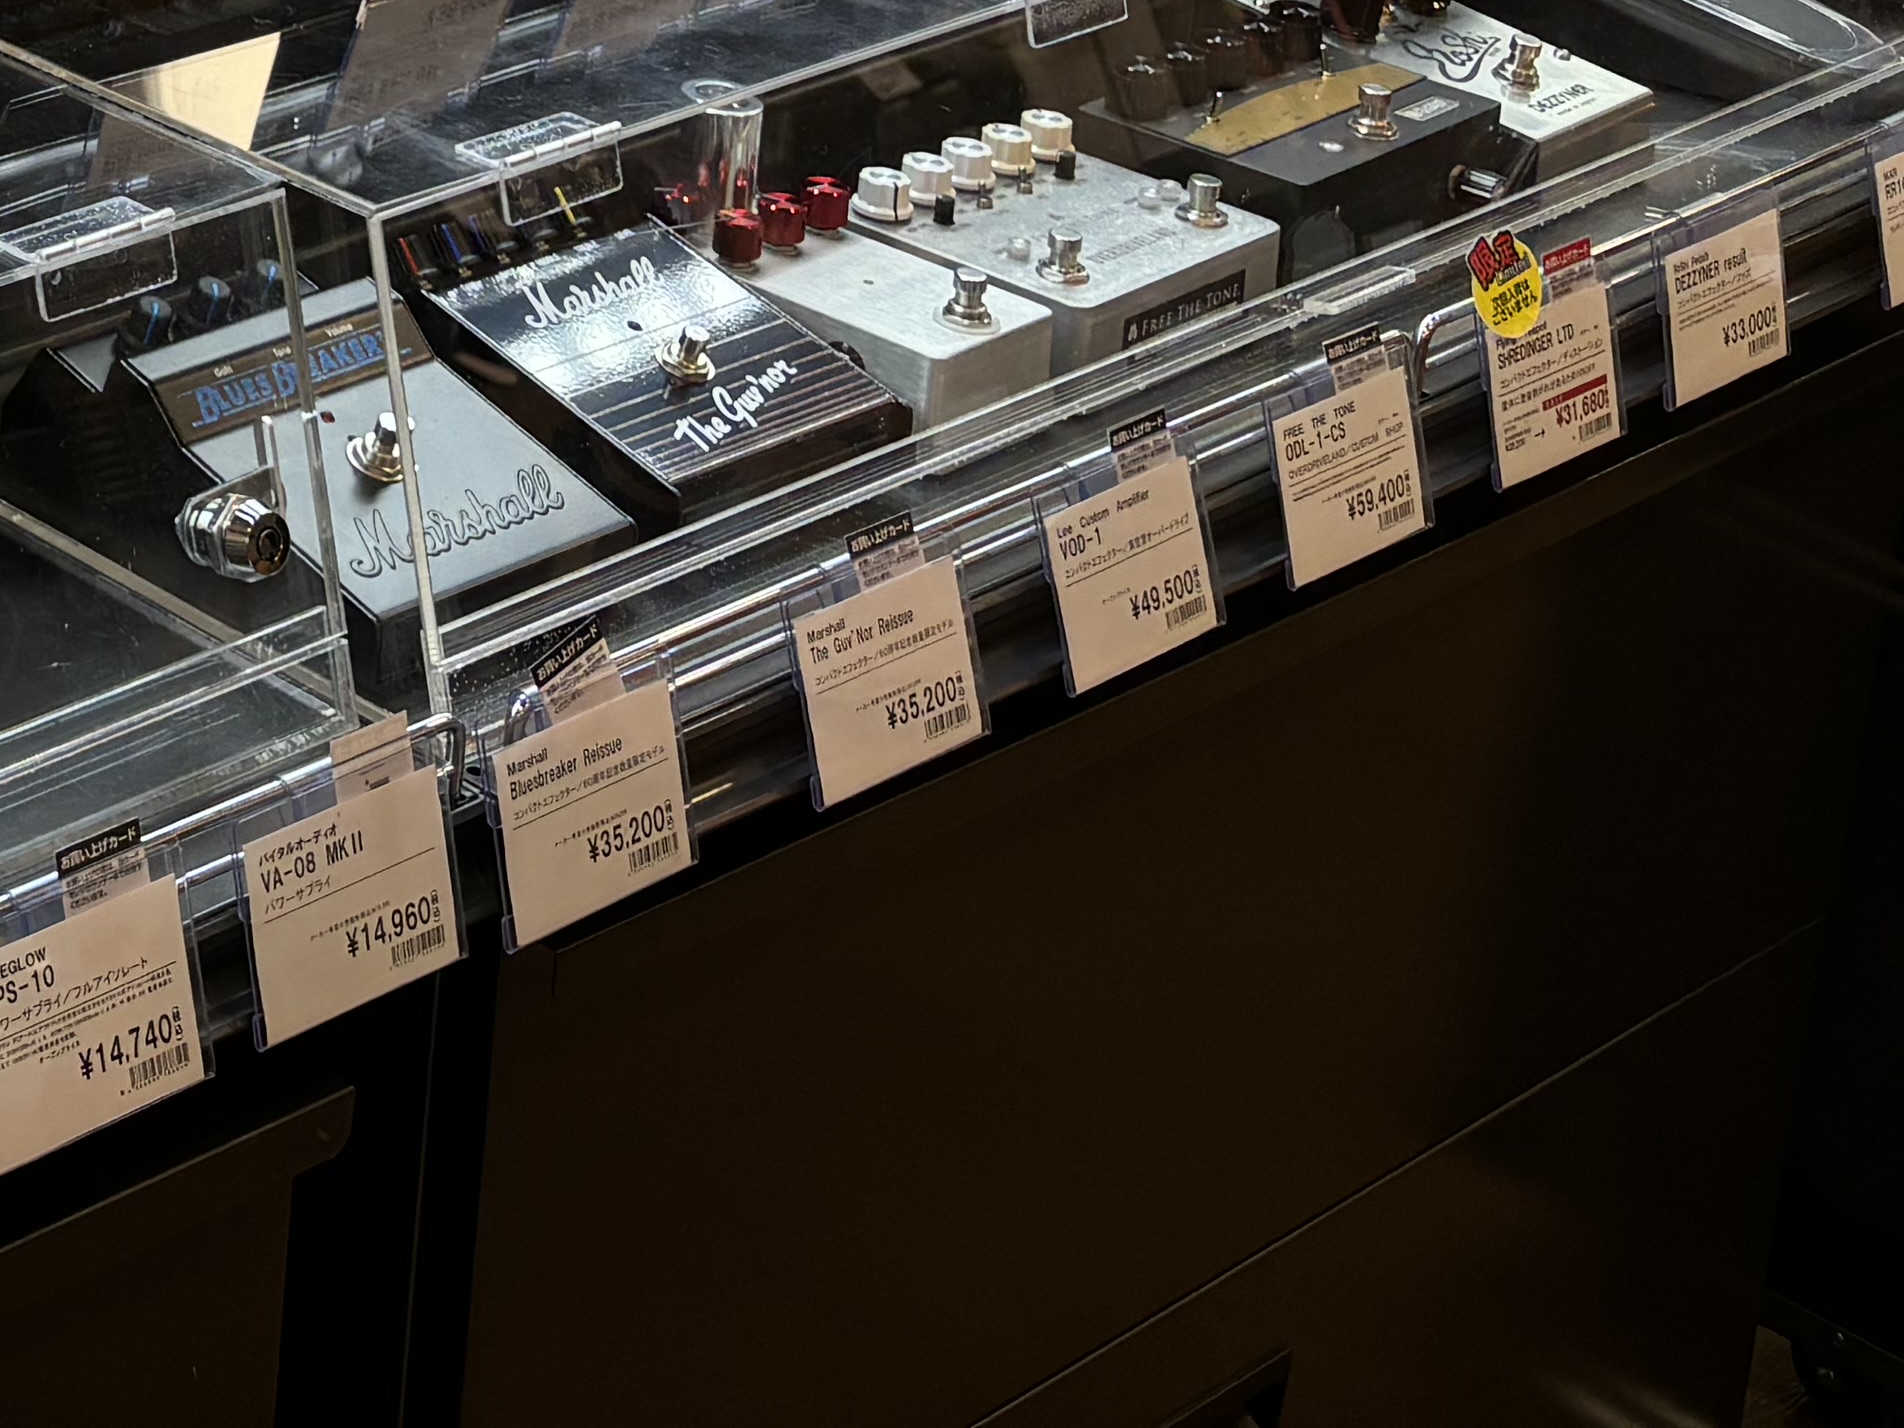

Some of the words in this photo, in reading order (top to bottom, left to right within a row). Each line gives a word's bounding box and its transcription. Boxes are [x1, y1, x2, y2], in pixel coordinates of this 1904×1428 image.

[524, 255, 663, 331] Marshall
[1346, 475, 1404, 521] ¥59,400
[1059, 528, 1101, 561] VOD-1
[1130, 571, 1194, 619] ¥49,500
[510, 756, 577, 799] Bluesbreaker
[584, 738, 622, 770] Reissue
[588, 806, 666, 863] ¥35,200
[79, 1015, 174, 1079] ¥14,740
